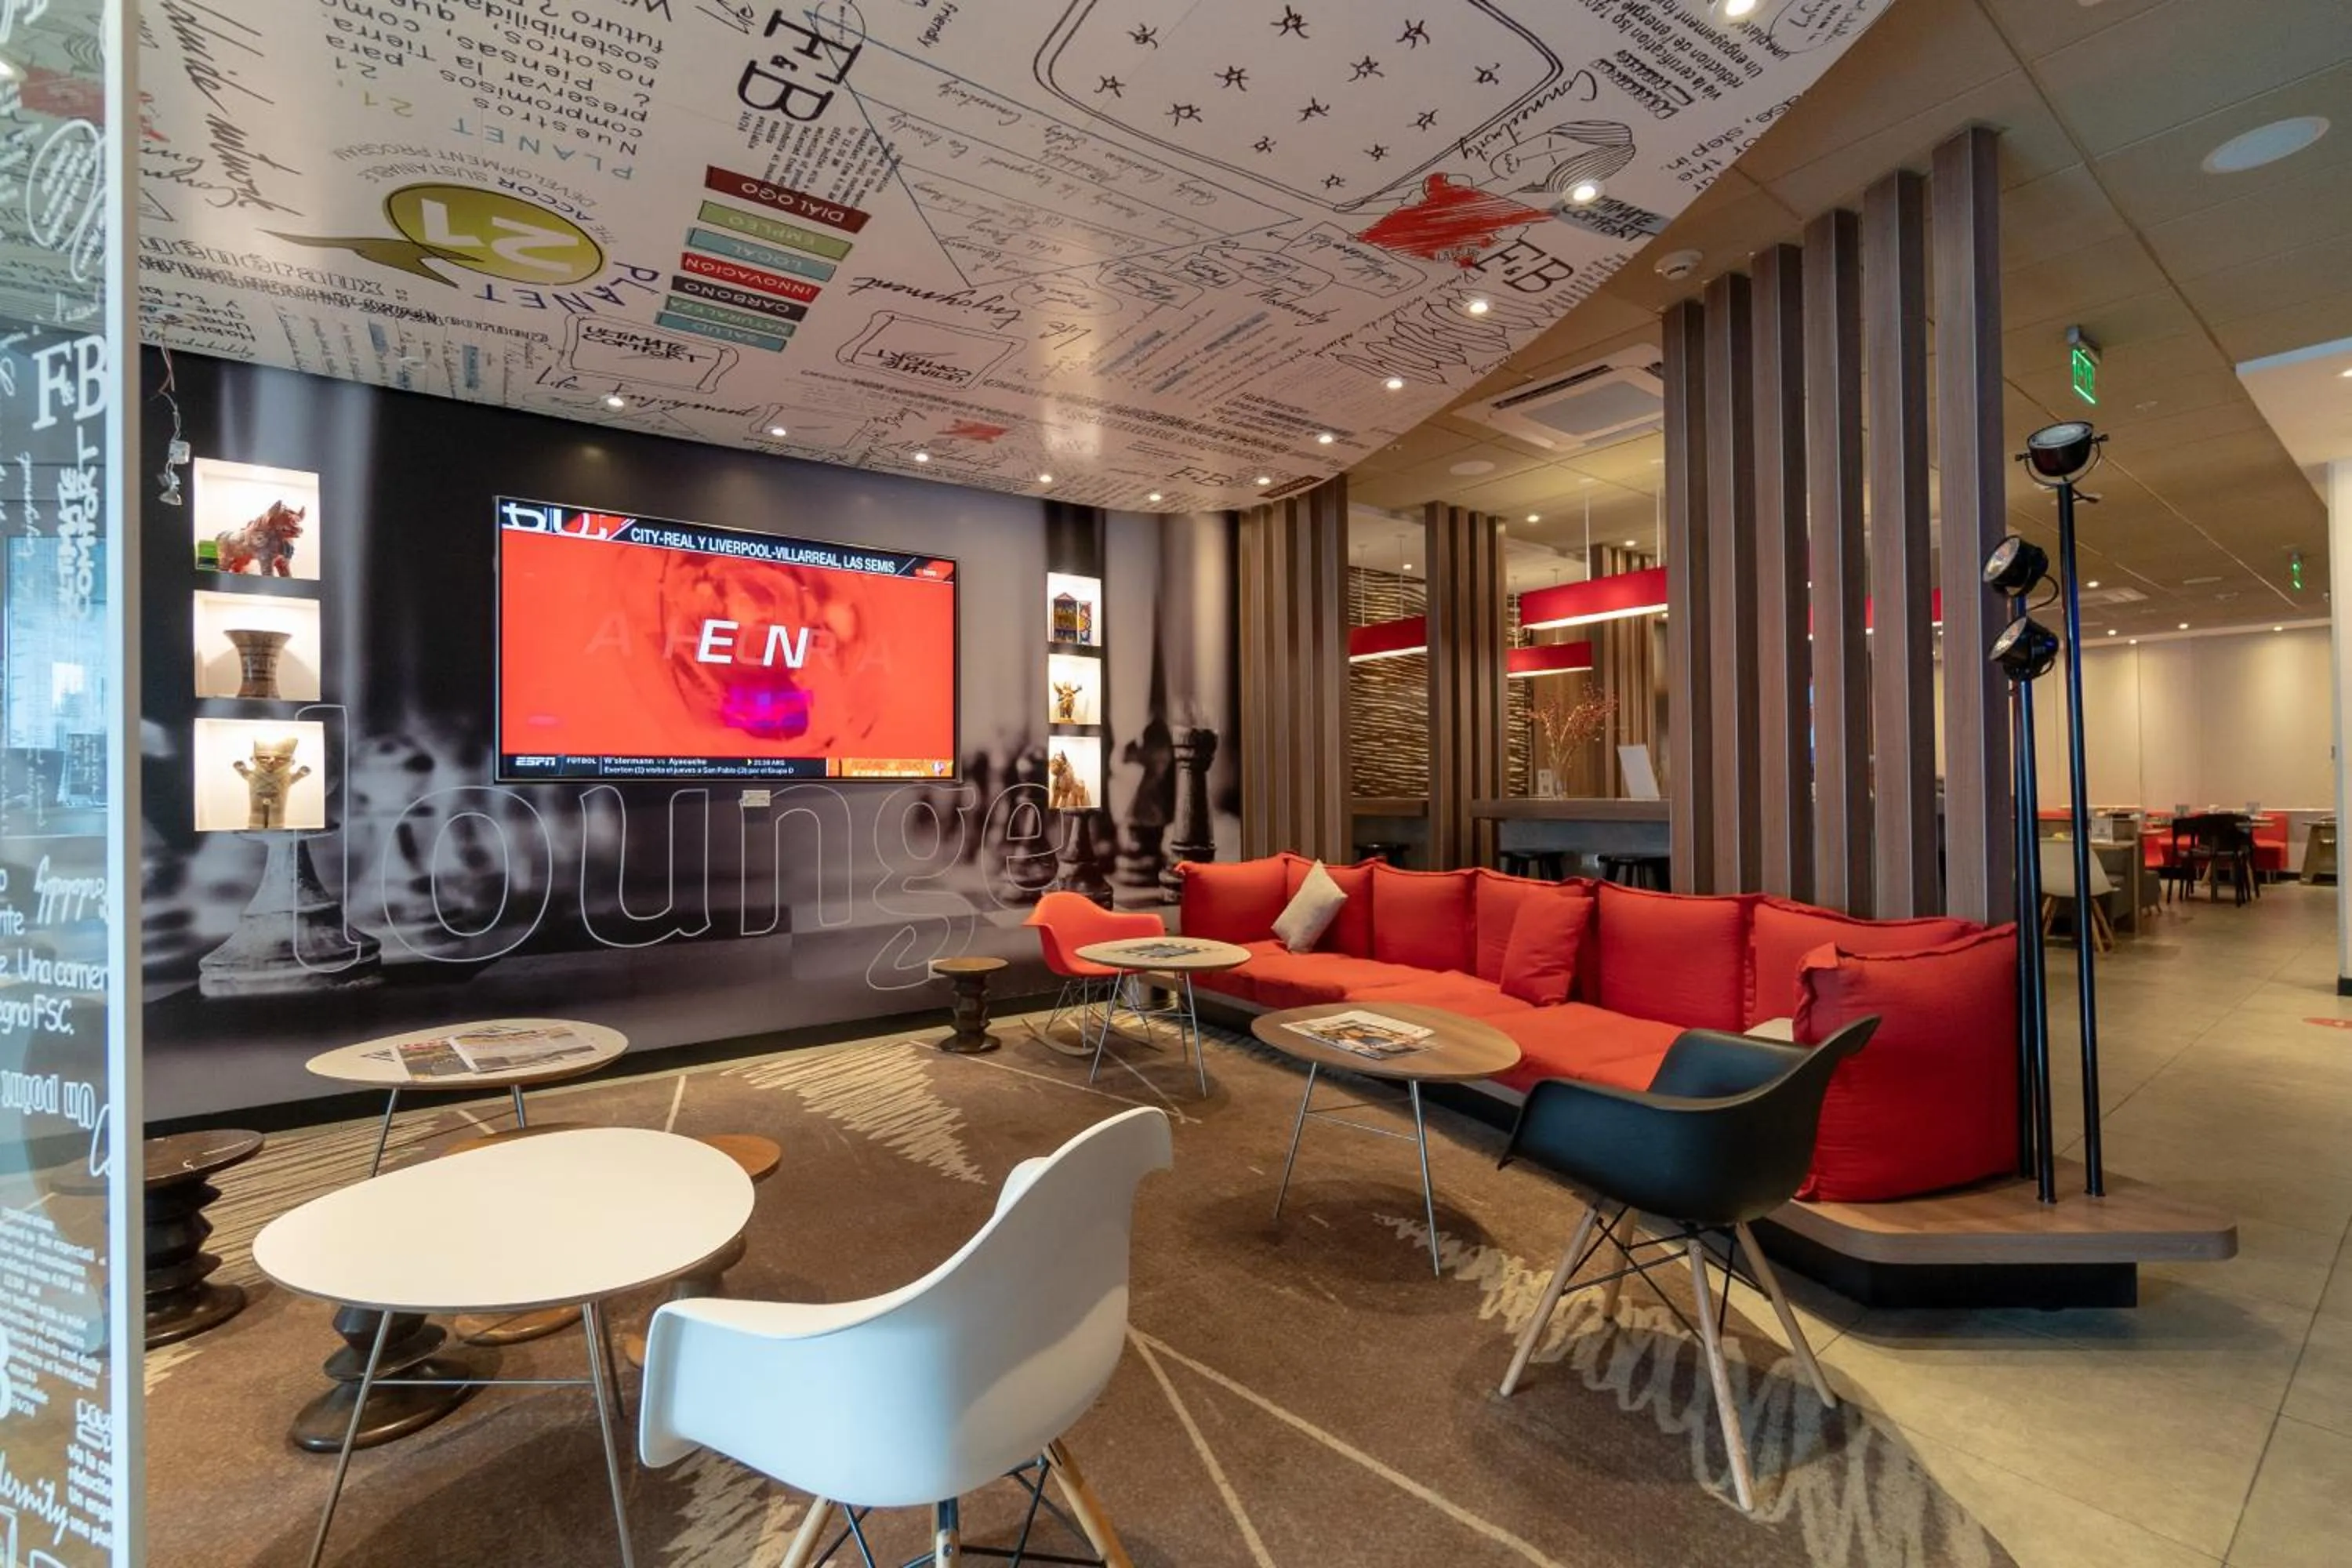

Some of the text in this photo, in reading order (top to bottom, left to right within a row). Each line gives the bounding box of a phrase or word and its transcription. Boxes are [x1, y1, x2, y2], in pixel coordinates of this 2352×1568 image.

[444, 0, 659, 70] sostenibilida
[572, 10, 664, 54] futuro
[326, 34, 642, 137] compromisos para
[456, 56, 482, 75] la
[504, 71, 648, 122] preservar
[364, 92, 633, 180] PLANET 21
[473, 96, 638, 156] Nuestros
[495, 177, 595, 223] ACCOR
[420, 197, 579, 274] 21
[473, 261, 660, 314] PLANET
[684, 282, 791, 313] CARBONO
[669, 300, 786, 332] NATURALEZA
[691, 321, 760, 342] SALUD
[630, 528, 895, 575] CITY-REAL Y LIVERPOOL-VILLARREAL, LAS SEMIS
[515, 756, 556, 766] ESPN
[293, 704, 1070, 991] lounge
[54, 960, 108, 993] camer
[33, 993, 75, 1036] FSC.
